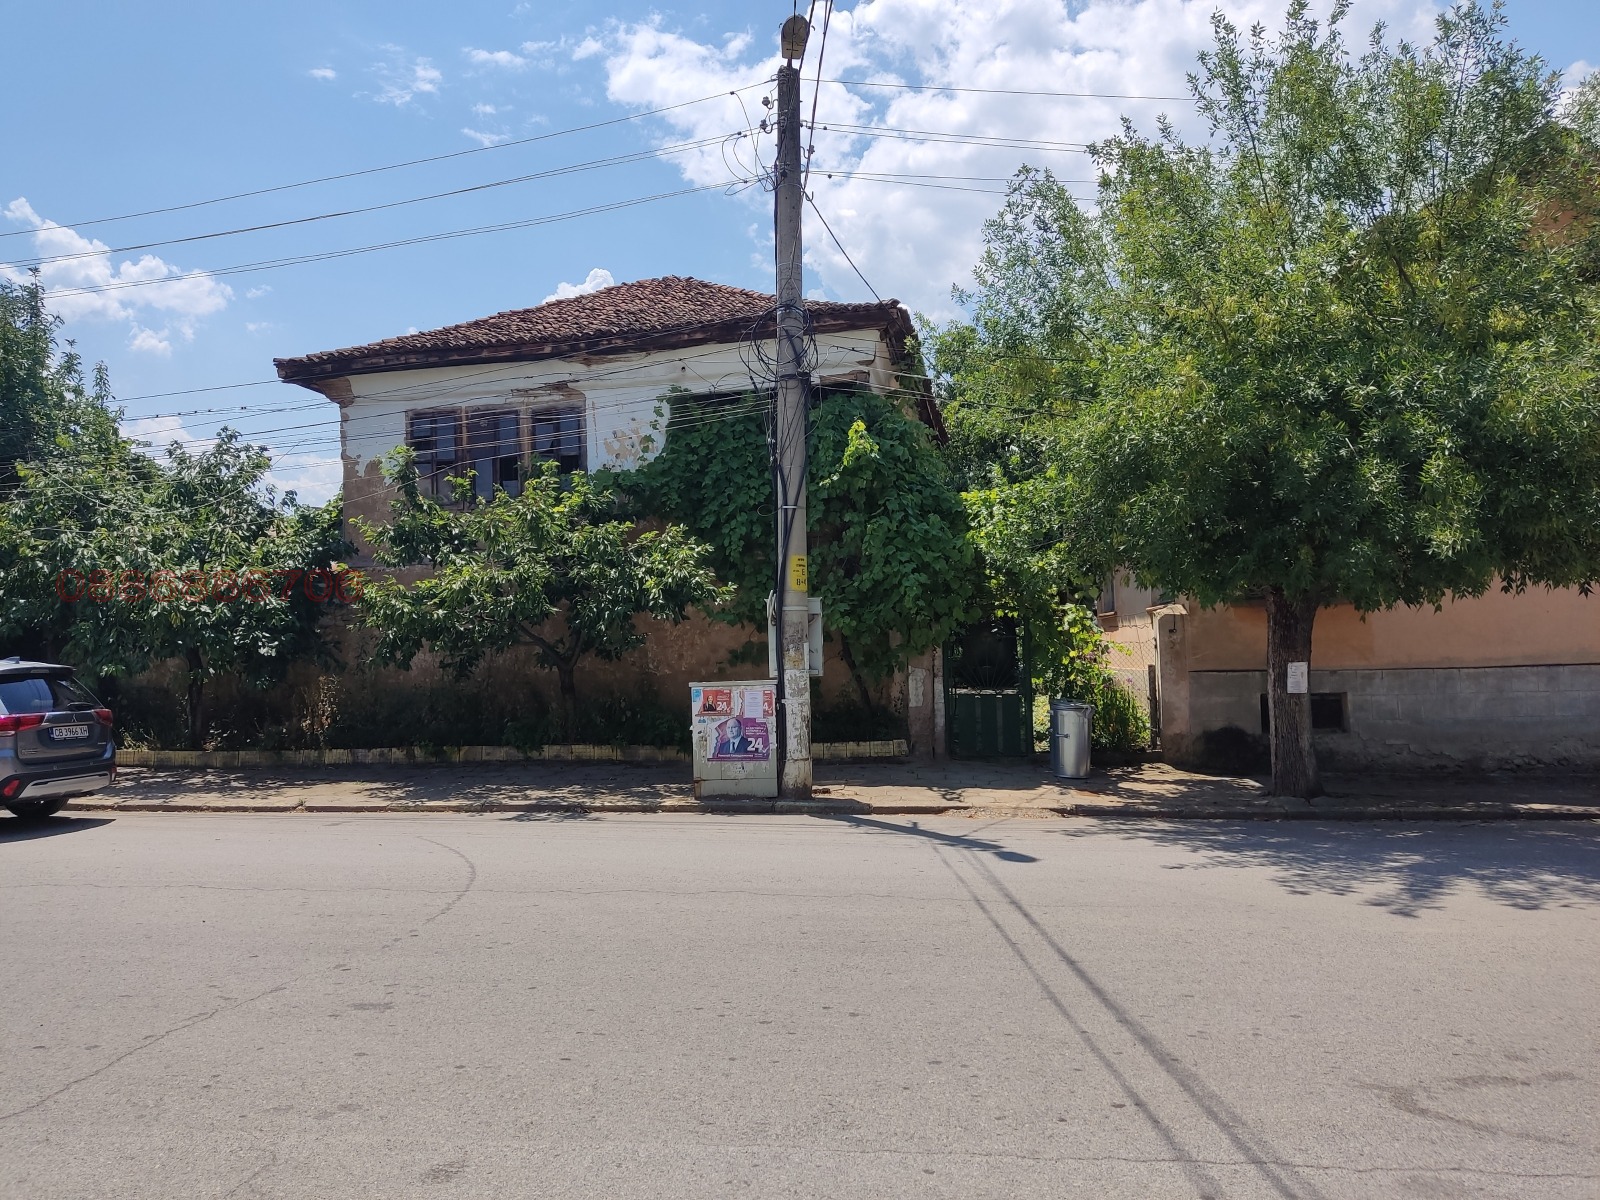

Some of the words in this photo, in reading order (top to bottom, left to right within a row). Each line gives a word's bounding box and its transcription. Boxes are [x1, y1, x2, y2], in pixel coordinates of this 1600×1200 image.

[717, 702, 727, 711] 24
[55, 728, 63, 737] CB
[64, 727, 79, 736] 3966
[79, 727, 87, 735] XH
[747, 738, 763, 752] 24
